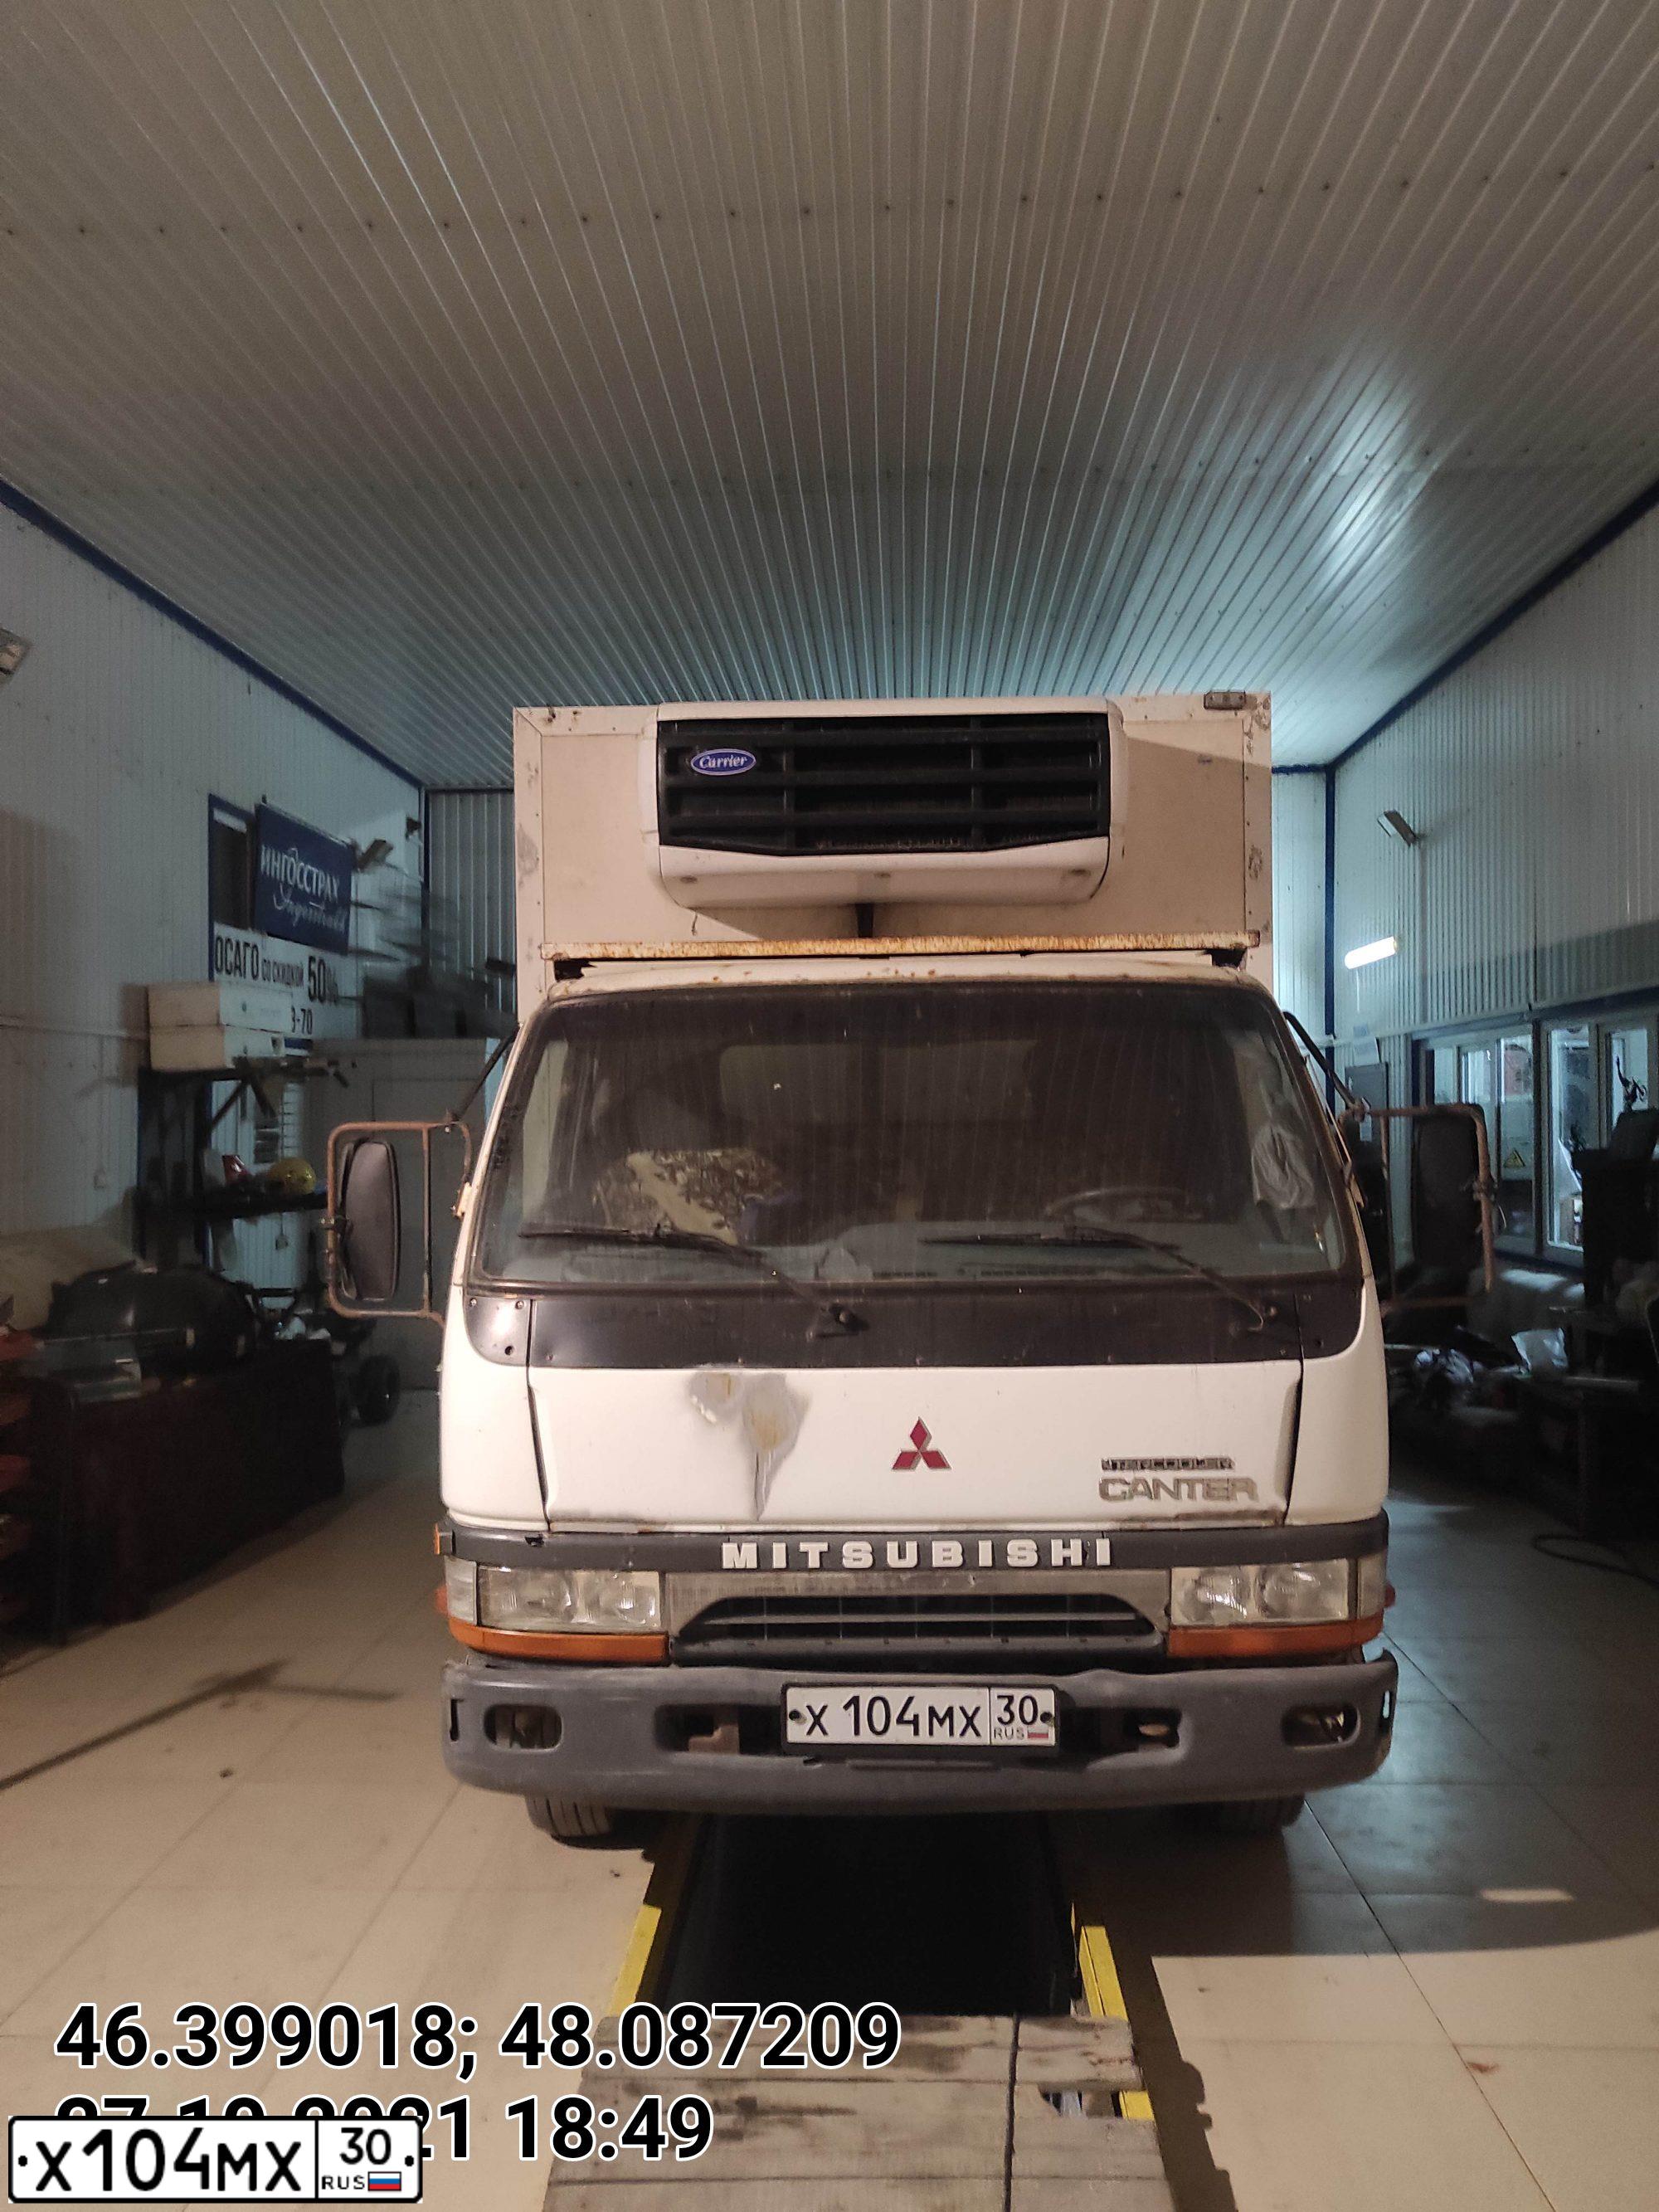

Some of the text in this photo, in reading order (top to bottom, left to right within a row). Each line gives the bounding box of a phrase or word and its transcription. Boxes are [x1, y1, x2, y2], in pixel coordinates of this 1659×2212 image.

[698, 754, 748, 768] Carrier
[214, 935, 260, 982] ОСАГО
[1098, 1477, 1259, 1503] CANTER
[721, 1538, 1112, 1569] MITSUBISHI
[996, 1694, 1039, 1726] 30
[993, 1727, 1025, 1740] RUS
